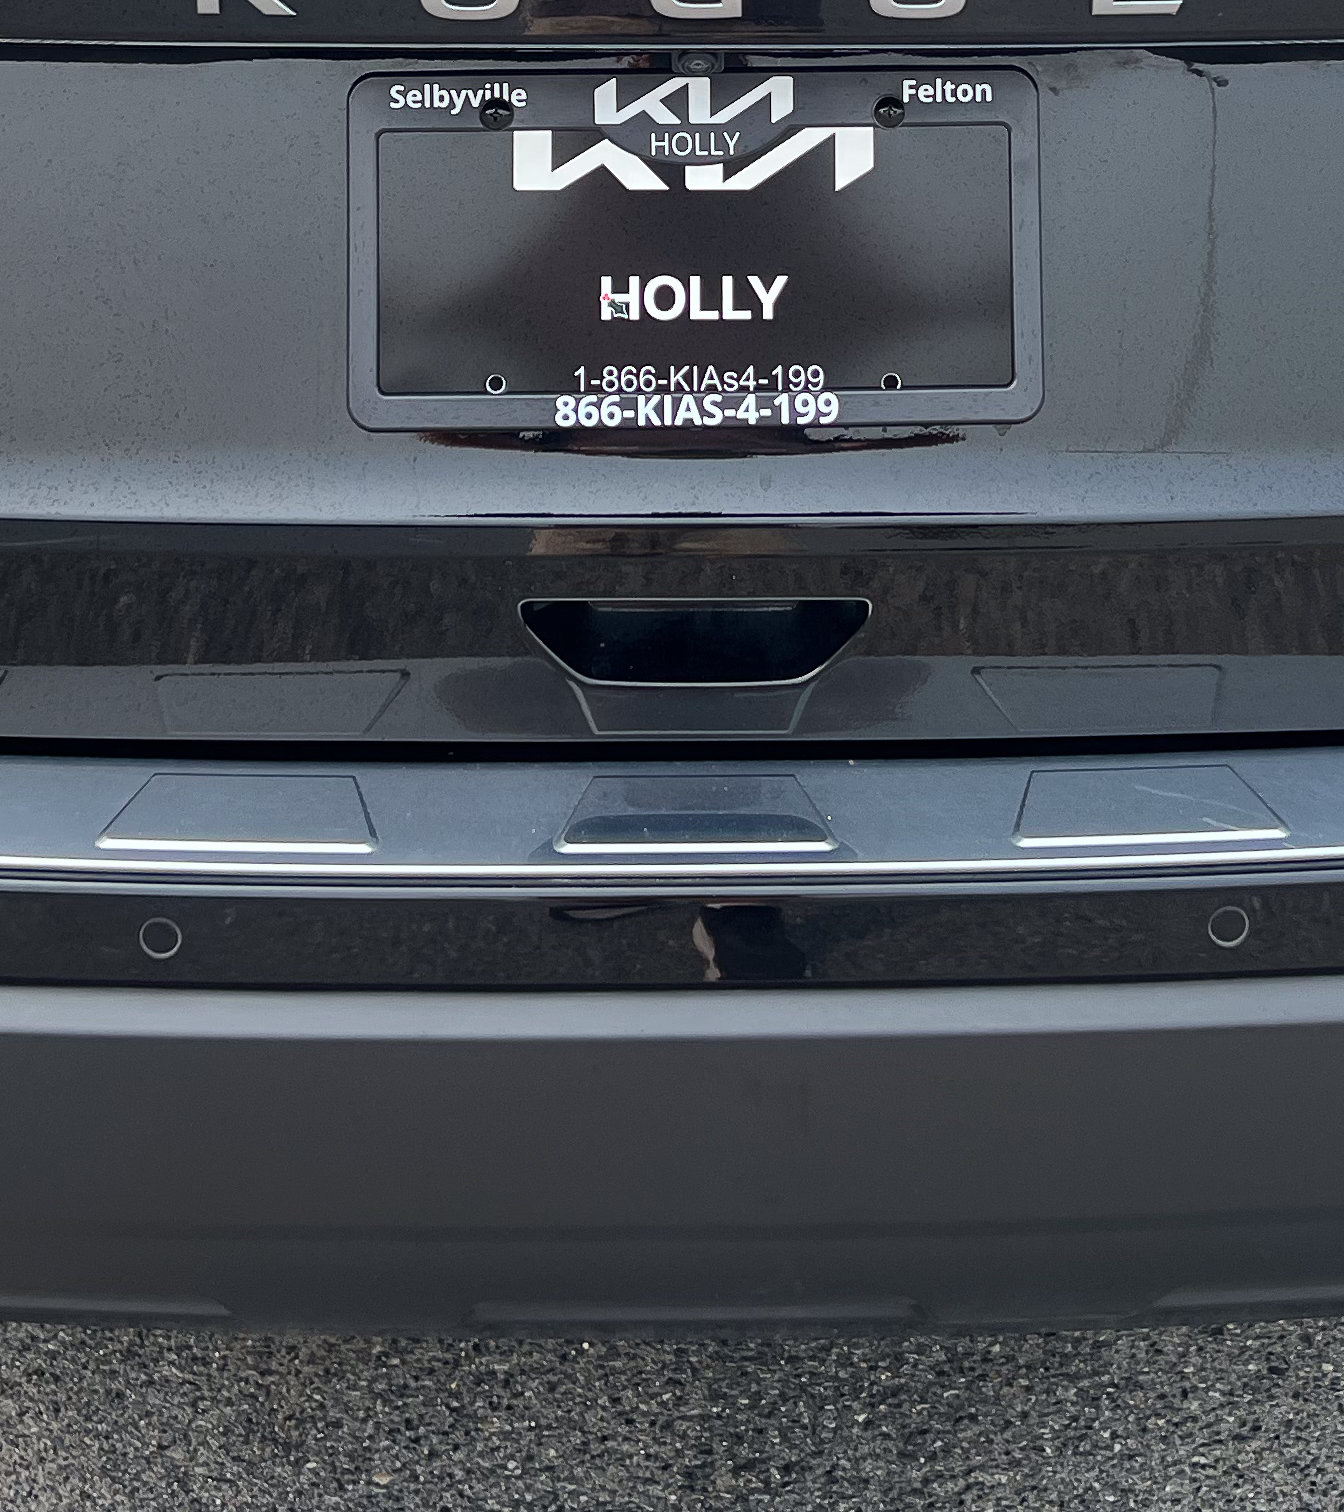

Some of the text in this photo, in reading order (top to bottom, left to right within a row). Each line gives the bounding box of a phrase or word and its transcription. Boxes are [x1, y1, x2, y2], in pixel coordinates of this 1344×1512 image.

[388, 82, 529, 115] Selbyville
[593, 75, 794, 125] KIA
[901, 77, 993, 104] Felton
[650, 131, 741, 157] HOLLY
[600, 274, 790, 321] HOLLY
[573, 364, 825, 393] 1-866-KIAs4-199
[554, 392, 840, 427] 866-KIAS-4-199
